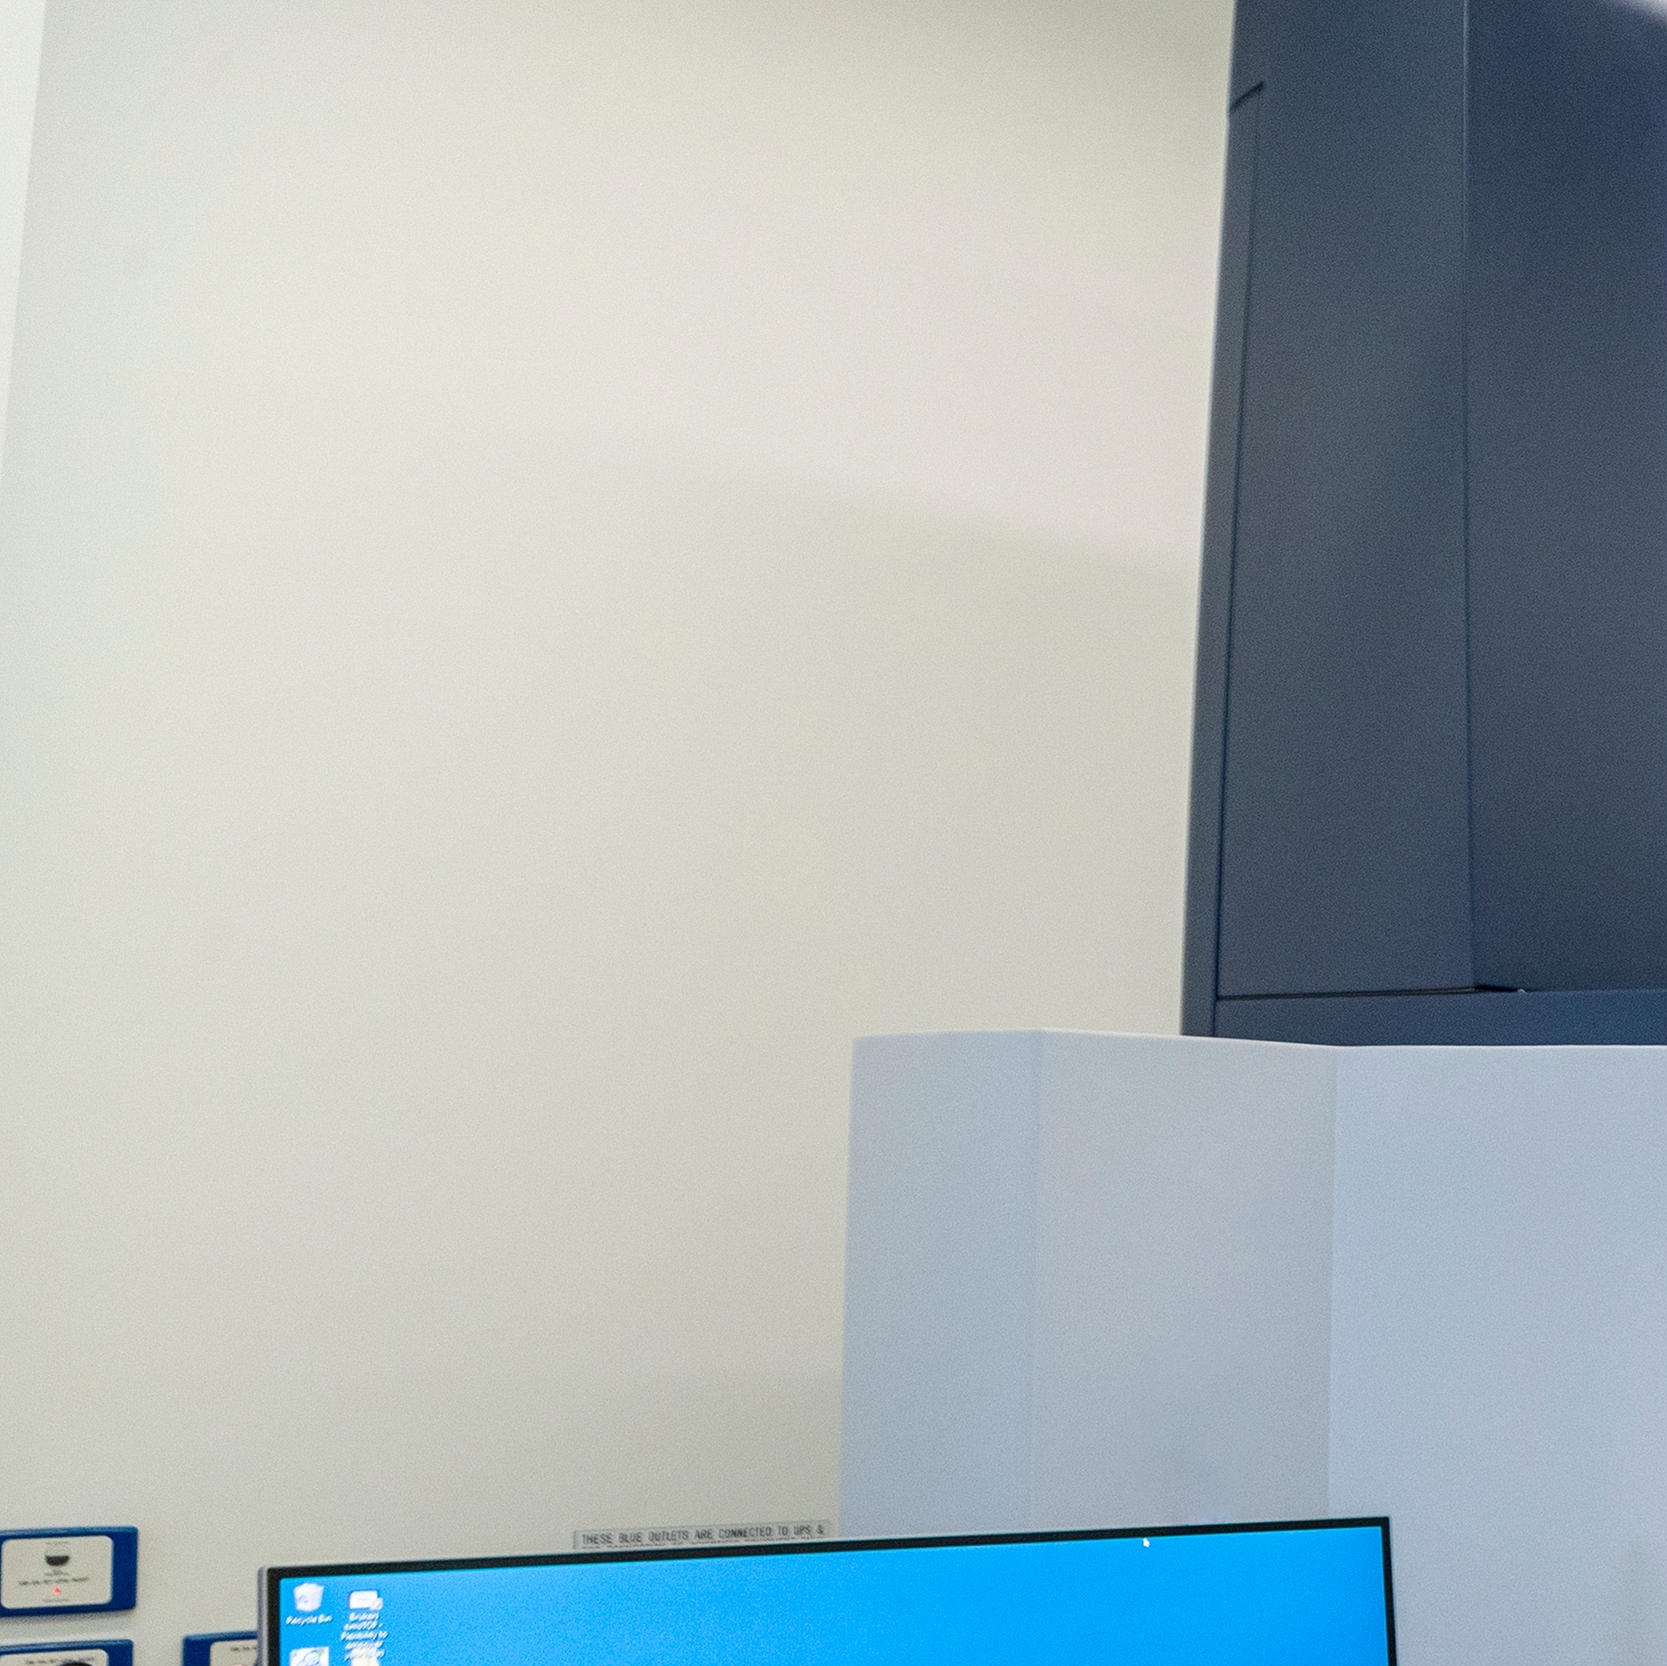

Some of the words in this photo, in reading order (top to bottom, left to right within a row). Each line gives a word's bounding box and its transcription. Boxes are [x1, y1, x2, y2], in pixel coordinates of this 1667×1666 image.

[582, 1532, 613, 1546] THESE
[618, 1531, 642, 1544] BLUE
[648, 1529, 689, 1543] OUTLETS
[694, 1528, 713, 1540] ARE
[718, 1526, 772, 1540] CONNECTED
[777, 1525, 789, 1537] TO
[793, 1524, 811, 1536] UPS
